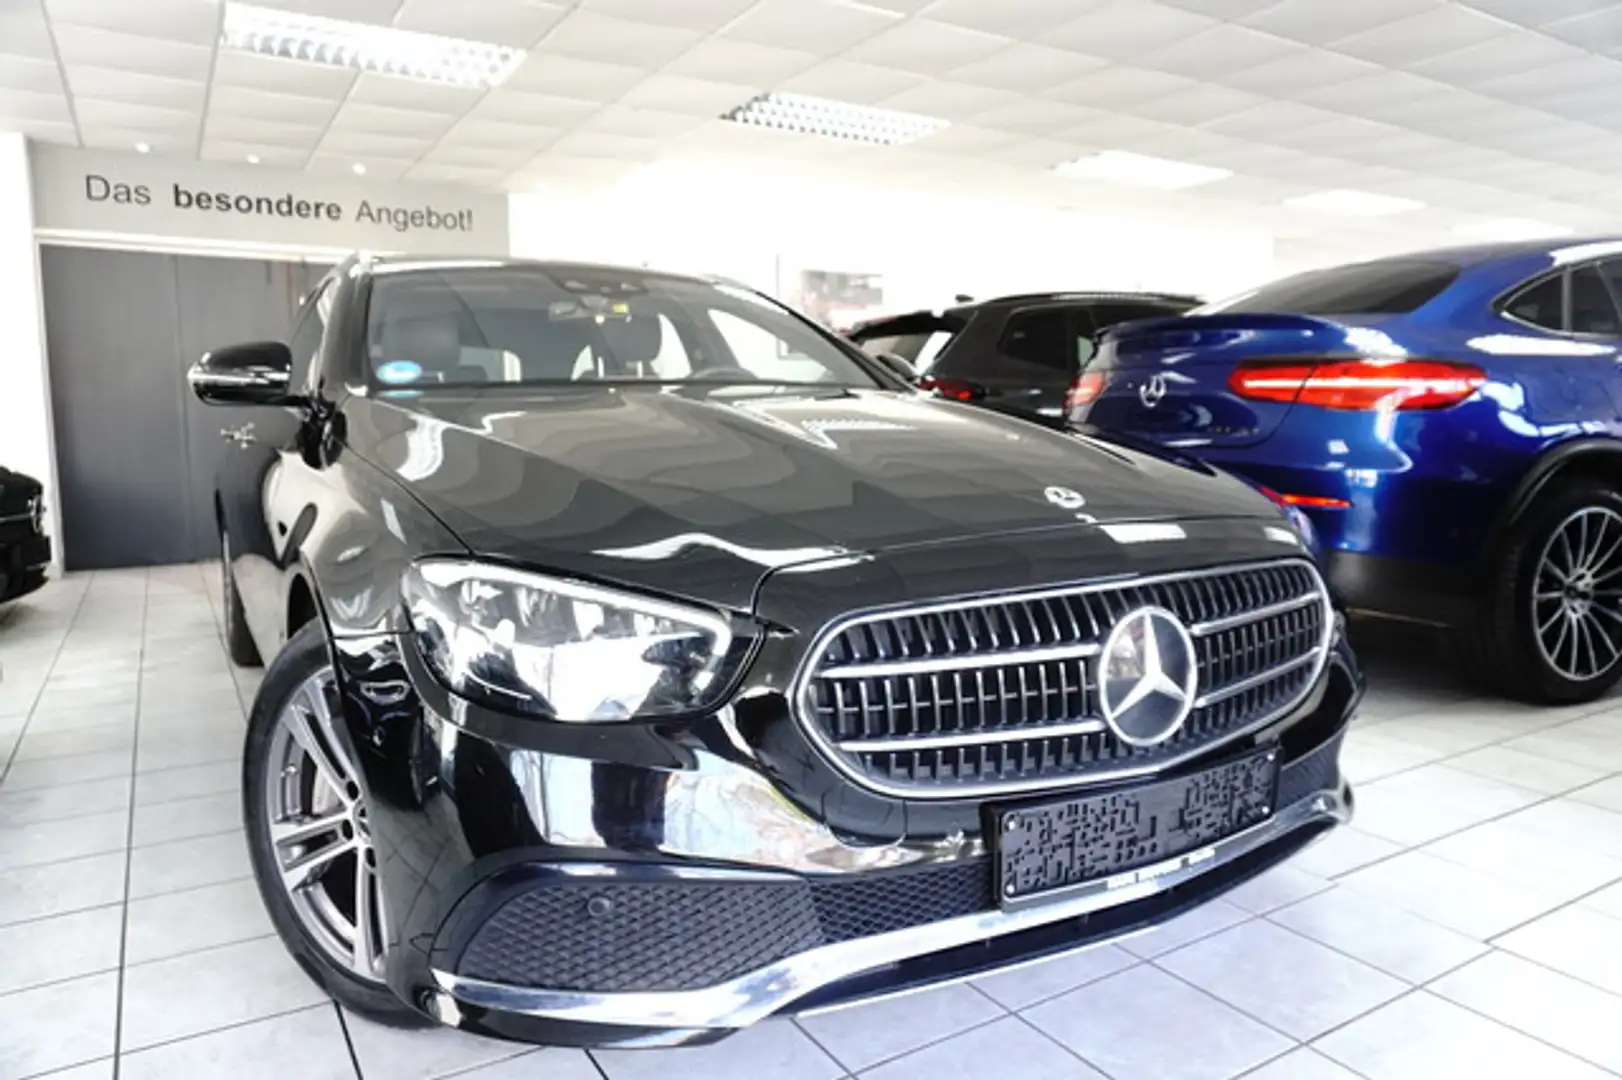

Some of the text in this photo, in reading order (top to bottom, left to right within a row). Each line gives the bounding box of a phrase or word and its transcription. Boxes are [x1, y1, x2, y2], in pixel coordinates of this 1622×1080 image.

[85, 174, 474, 233] Das besondere Angebot!
